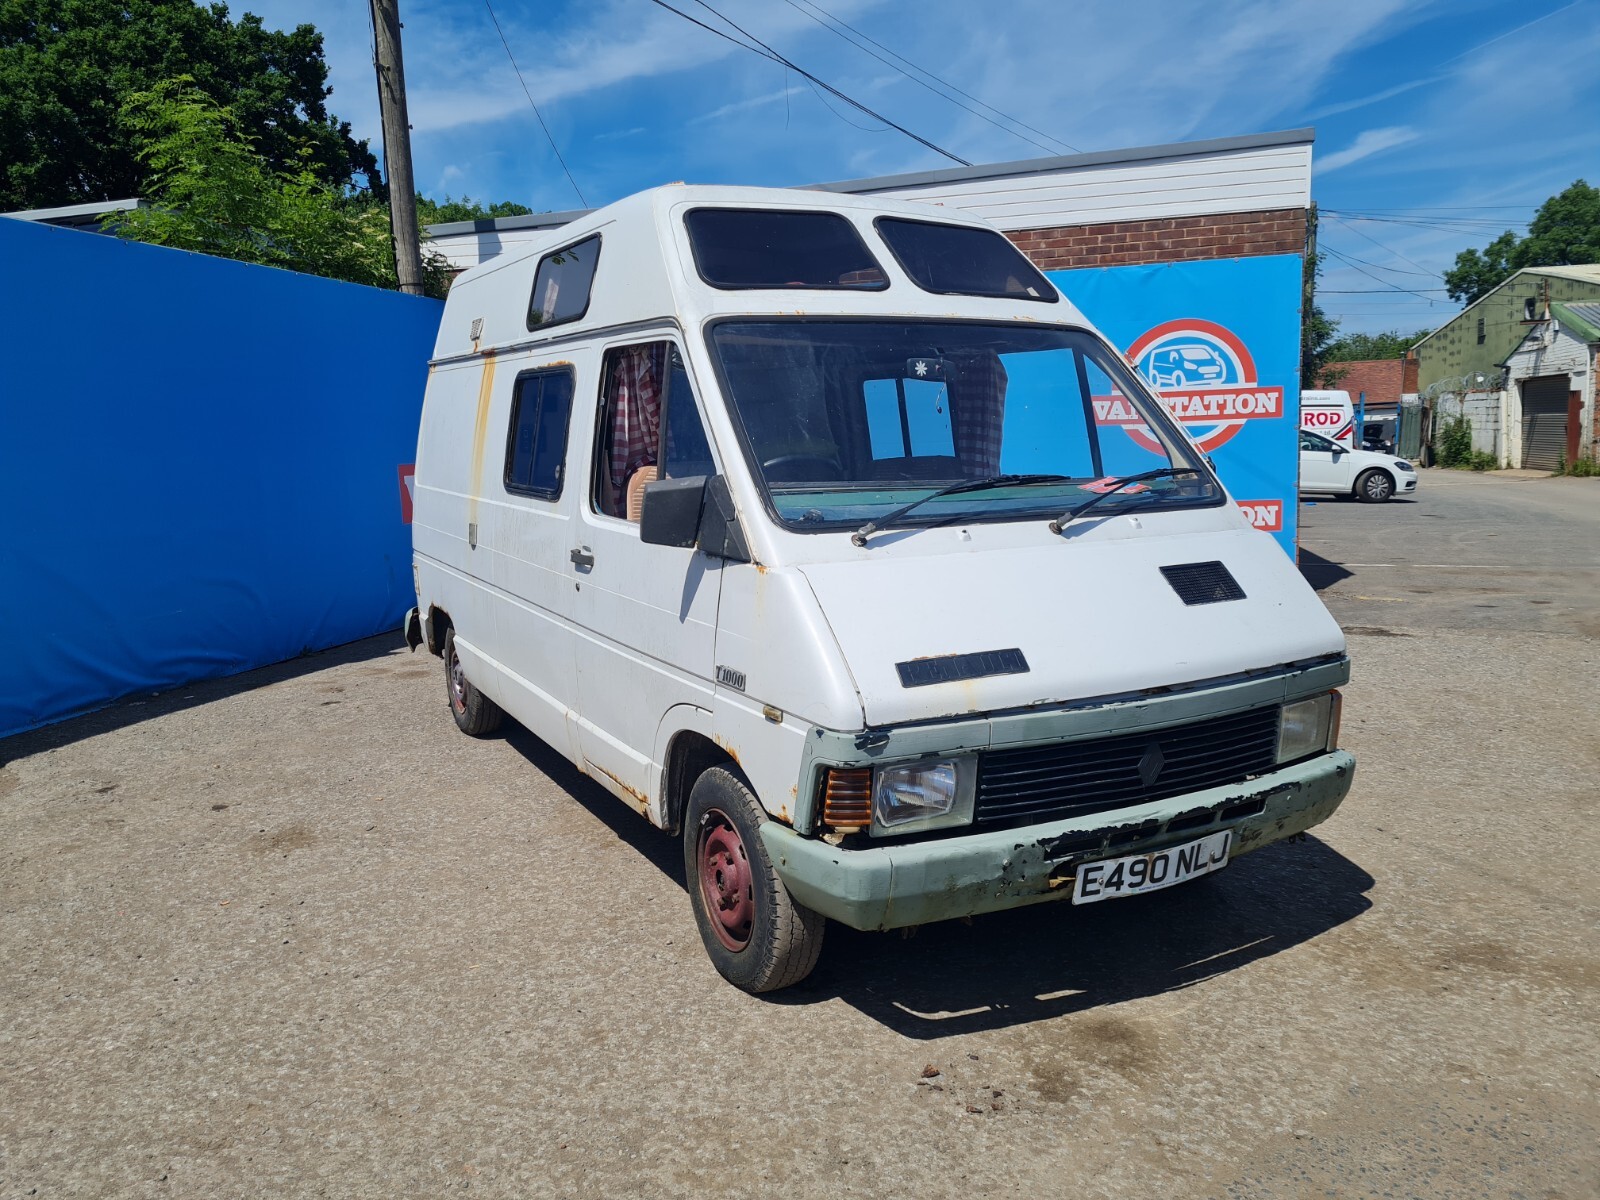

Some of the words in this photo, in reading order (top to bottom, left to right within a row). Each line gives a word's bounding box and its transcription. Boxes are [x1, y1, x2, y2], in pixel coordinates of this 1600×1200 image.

[1092, 392, 1279, 420] VATATION
[1304, 412, 1341, 426] ROD
[1081, 854, 1170, 898] E490
[1175, 833, 1230, 878] NLJ
